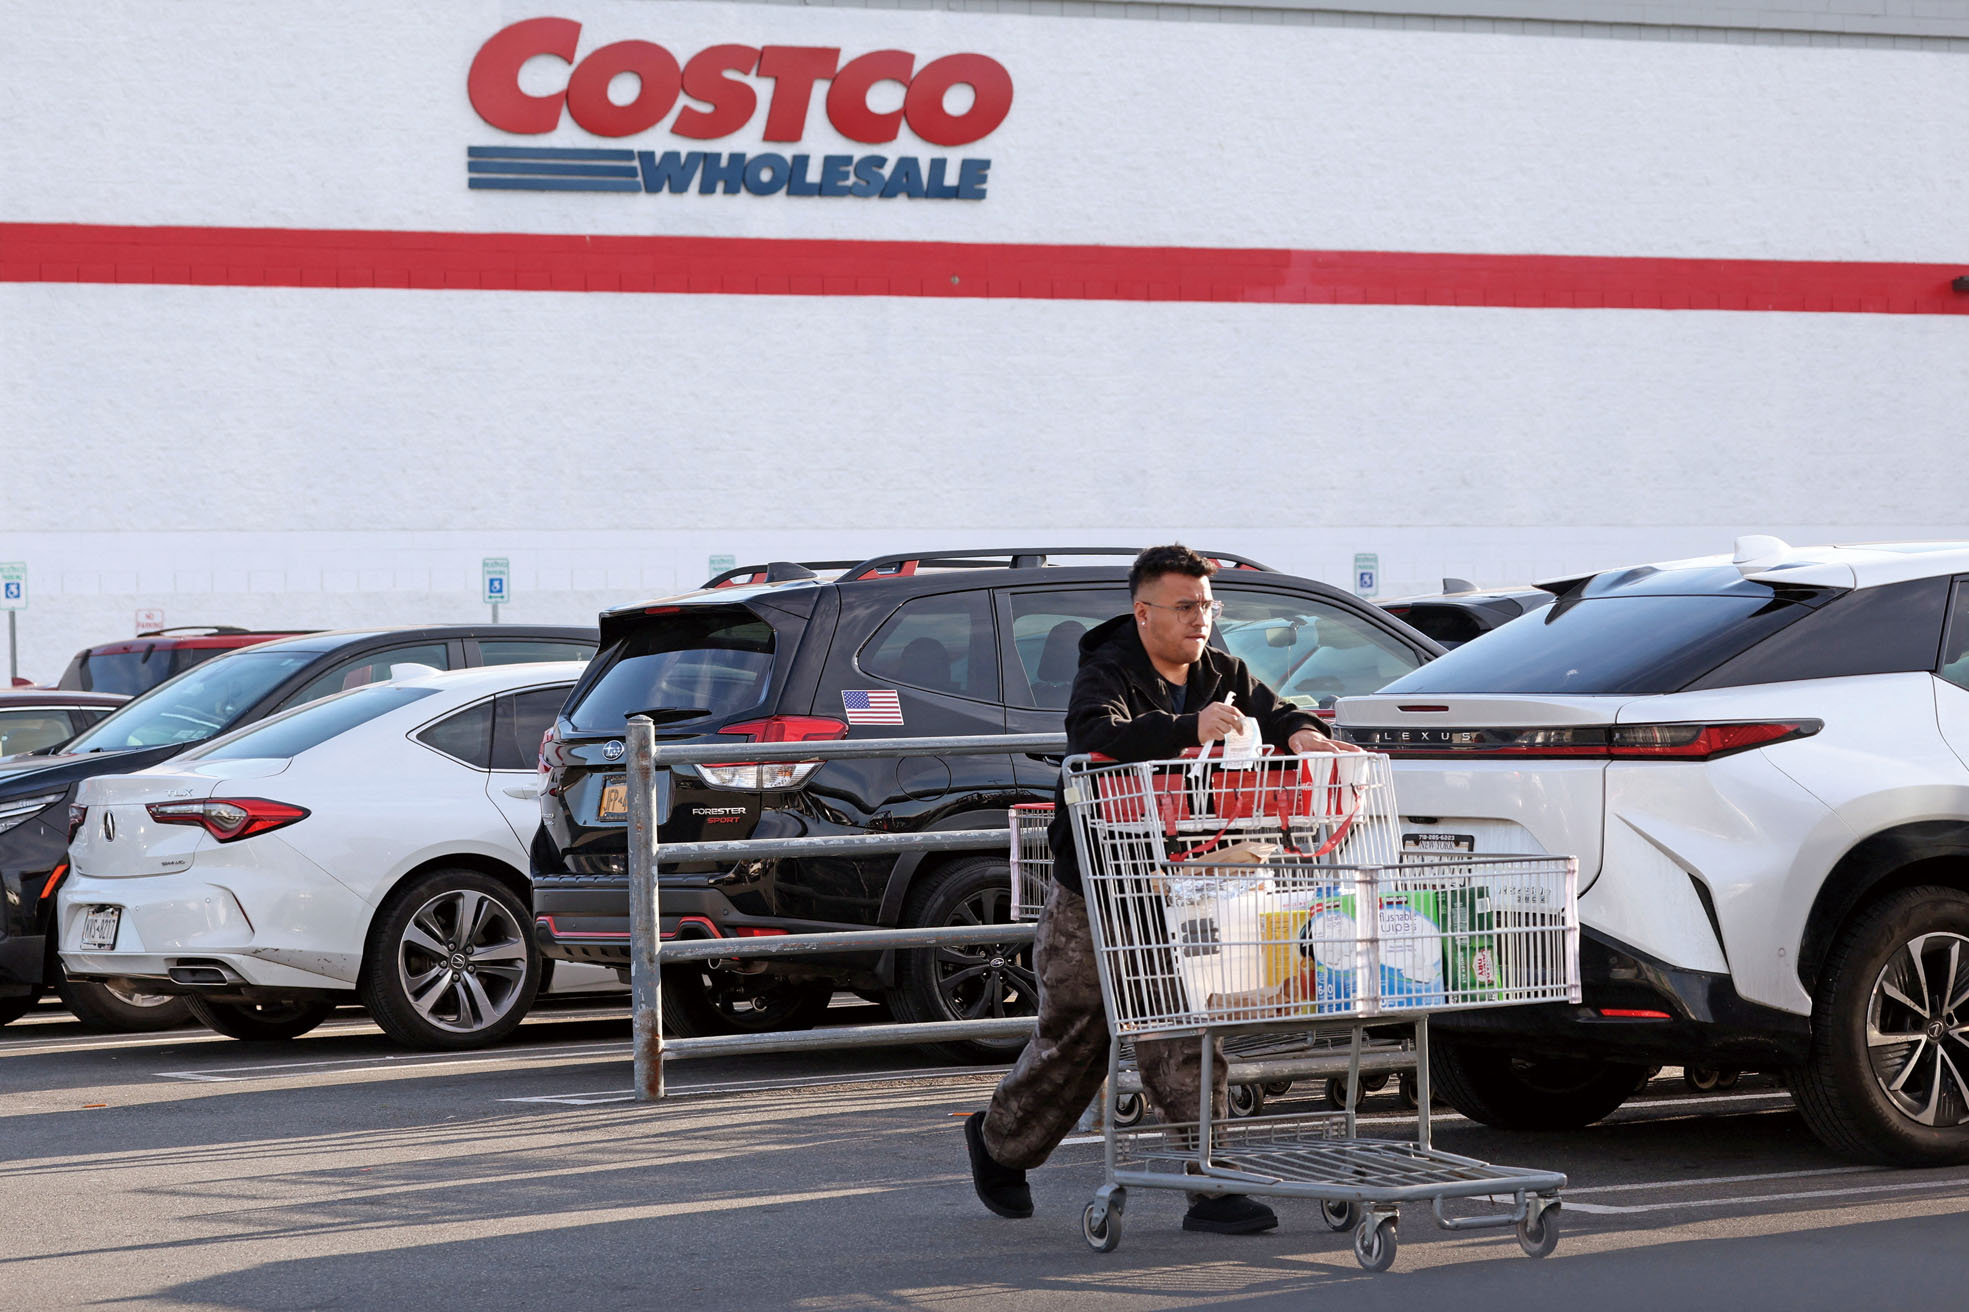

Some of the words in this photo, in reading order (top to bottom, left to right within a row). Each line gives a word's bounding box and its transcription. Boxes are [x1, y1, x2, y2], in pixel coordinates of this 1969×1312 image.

[467, 16, 1014, 147] COSTCO
[637, 150, 991, 201] WHOLESALE
[1384, 732, 1471, 740] LEXUS
[166, 789, 193, 797] TLX
[692, 807, 746, 815] FORESTER
[1420, 841, 1434, 850] NEW
[1436, 841, 1455, 851] YORK
